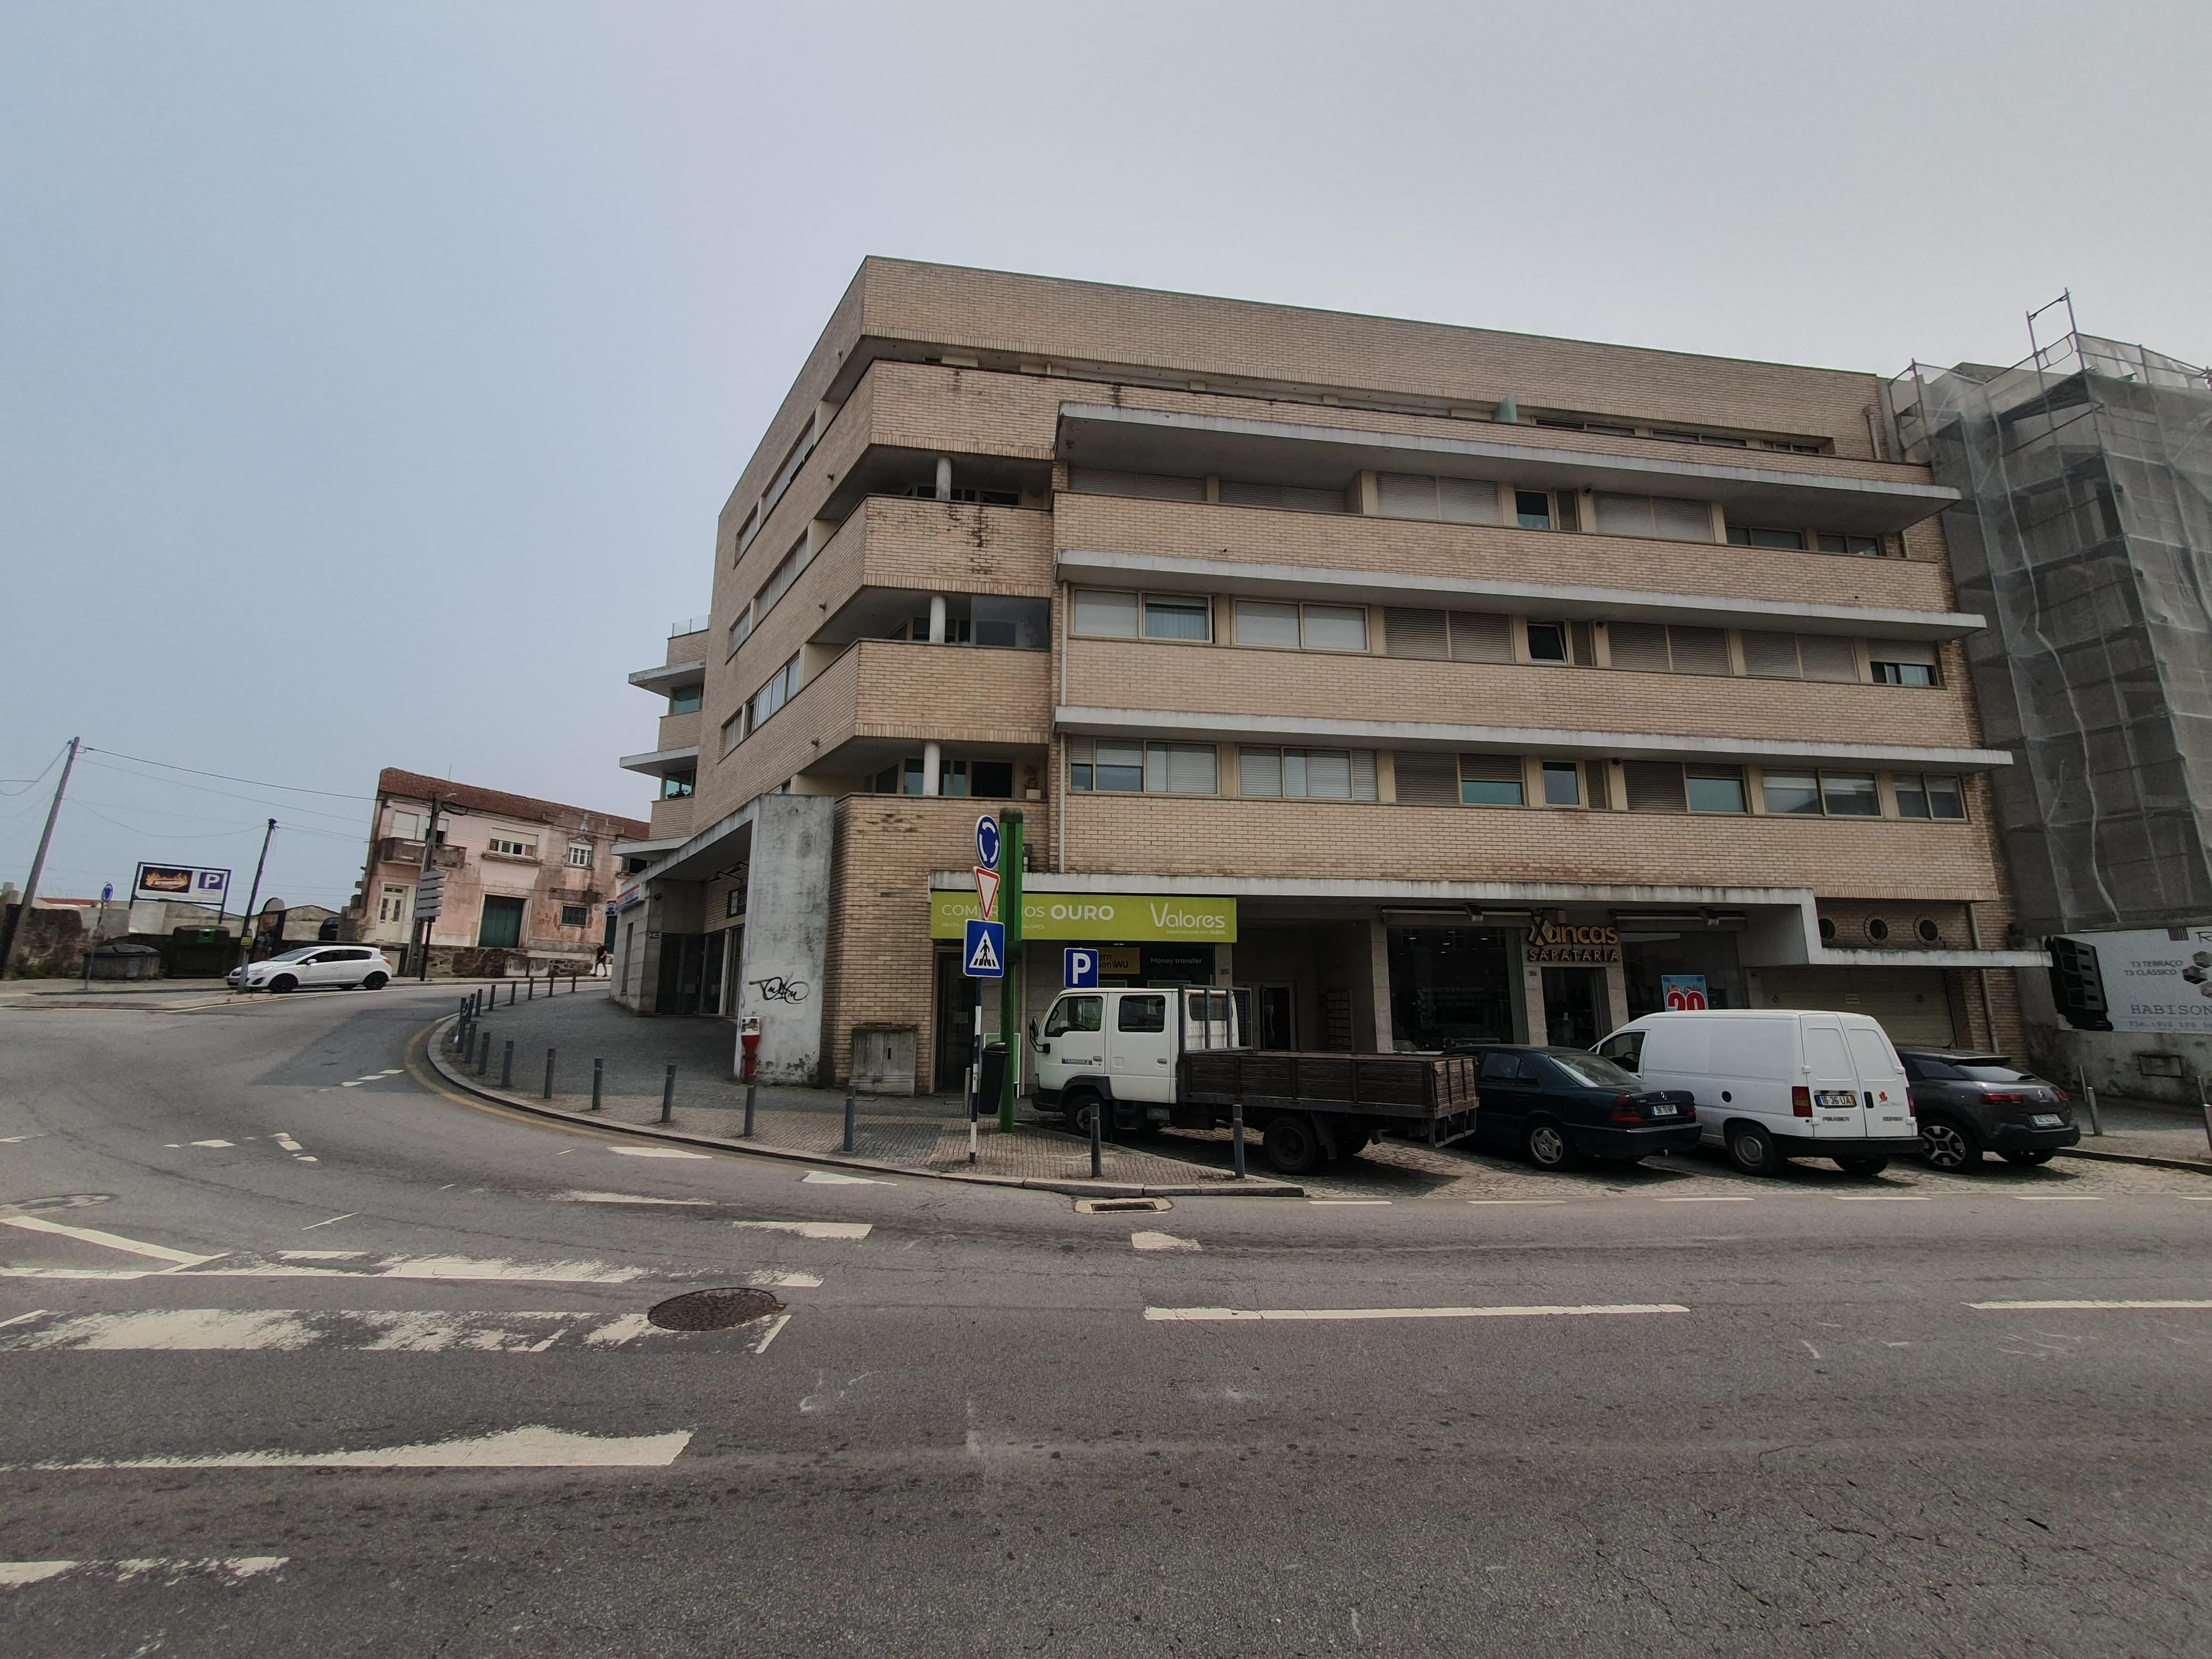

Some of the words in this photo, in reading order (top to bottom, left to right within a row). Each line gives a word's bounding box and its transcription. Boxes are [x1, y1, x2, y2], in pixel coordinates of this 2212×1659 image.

[941, 904, 1045, 918] COMROS
[1050, 904, 1115, 921] OURO
[1150, 903, 1225, 928] Valores
[1528, 916, 1619, 945] Xancas
[1150, 957, 1174, 965] Money
[1529, 950, 1620, 961] SAPATARIA
[2141, 960, 2183, 968] TERRAÇO
[1072, 952, 1092, 984] P
